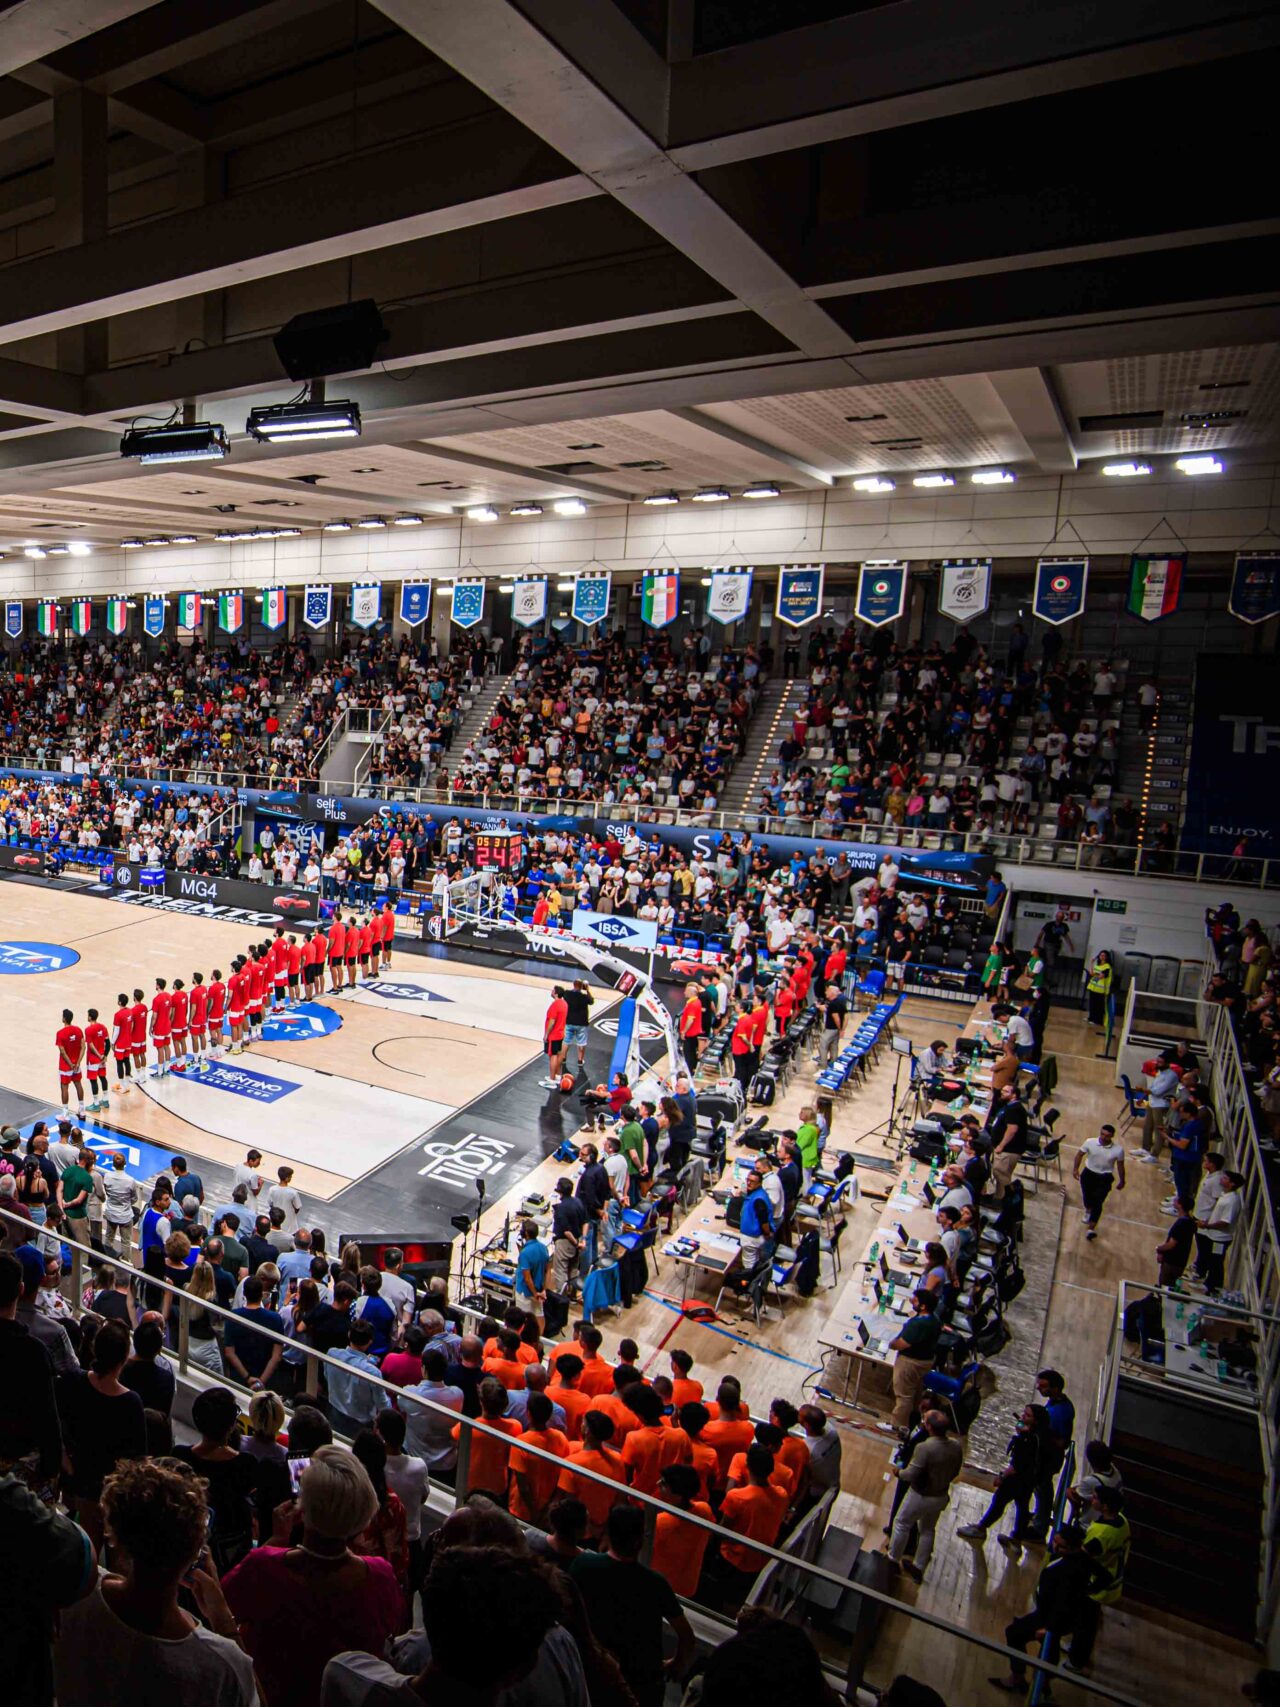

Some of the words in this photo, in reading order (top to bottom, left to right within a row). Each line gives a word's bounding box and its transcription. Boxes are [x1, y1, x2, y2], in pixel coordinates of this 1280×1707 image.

[317, 798, 335, 811] Self
[324, 809, 347, 821] Plus
[1209, 825, 1273, 839] ENJOY.
[477, 837, 489, 846] 05
[494, 837, 508, 847] 31
[476, 848, 506, 867] 24
[117, 868, 132, 883] MG
[181, 878, 218, 899] MG4
[109, 896, 143, 905] BLM
[144, 902, 200, 915] GROUP
[200, 913, 260, 926] ARENA
[117, 889, 284, 923] TRENTO
[598, 921, 630, 937] IBSA
[366, 982, 430, 1001] IBSA
[199, 1075, 245, 1091] BASKET
[246, 1086, 271, 1098] CUP
[212, 1068, 283, 1092] TRENTINO
